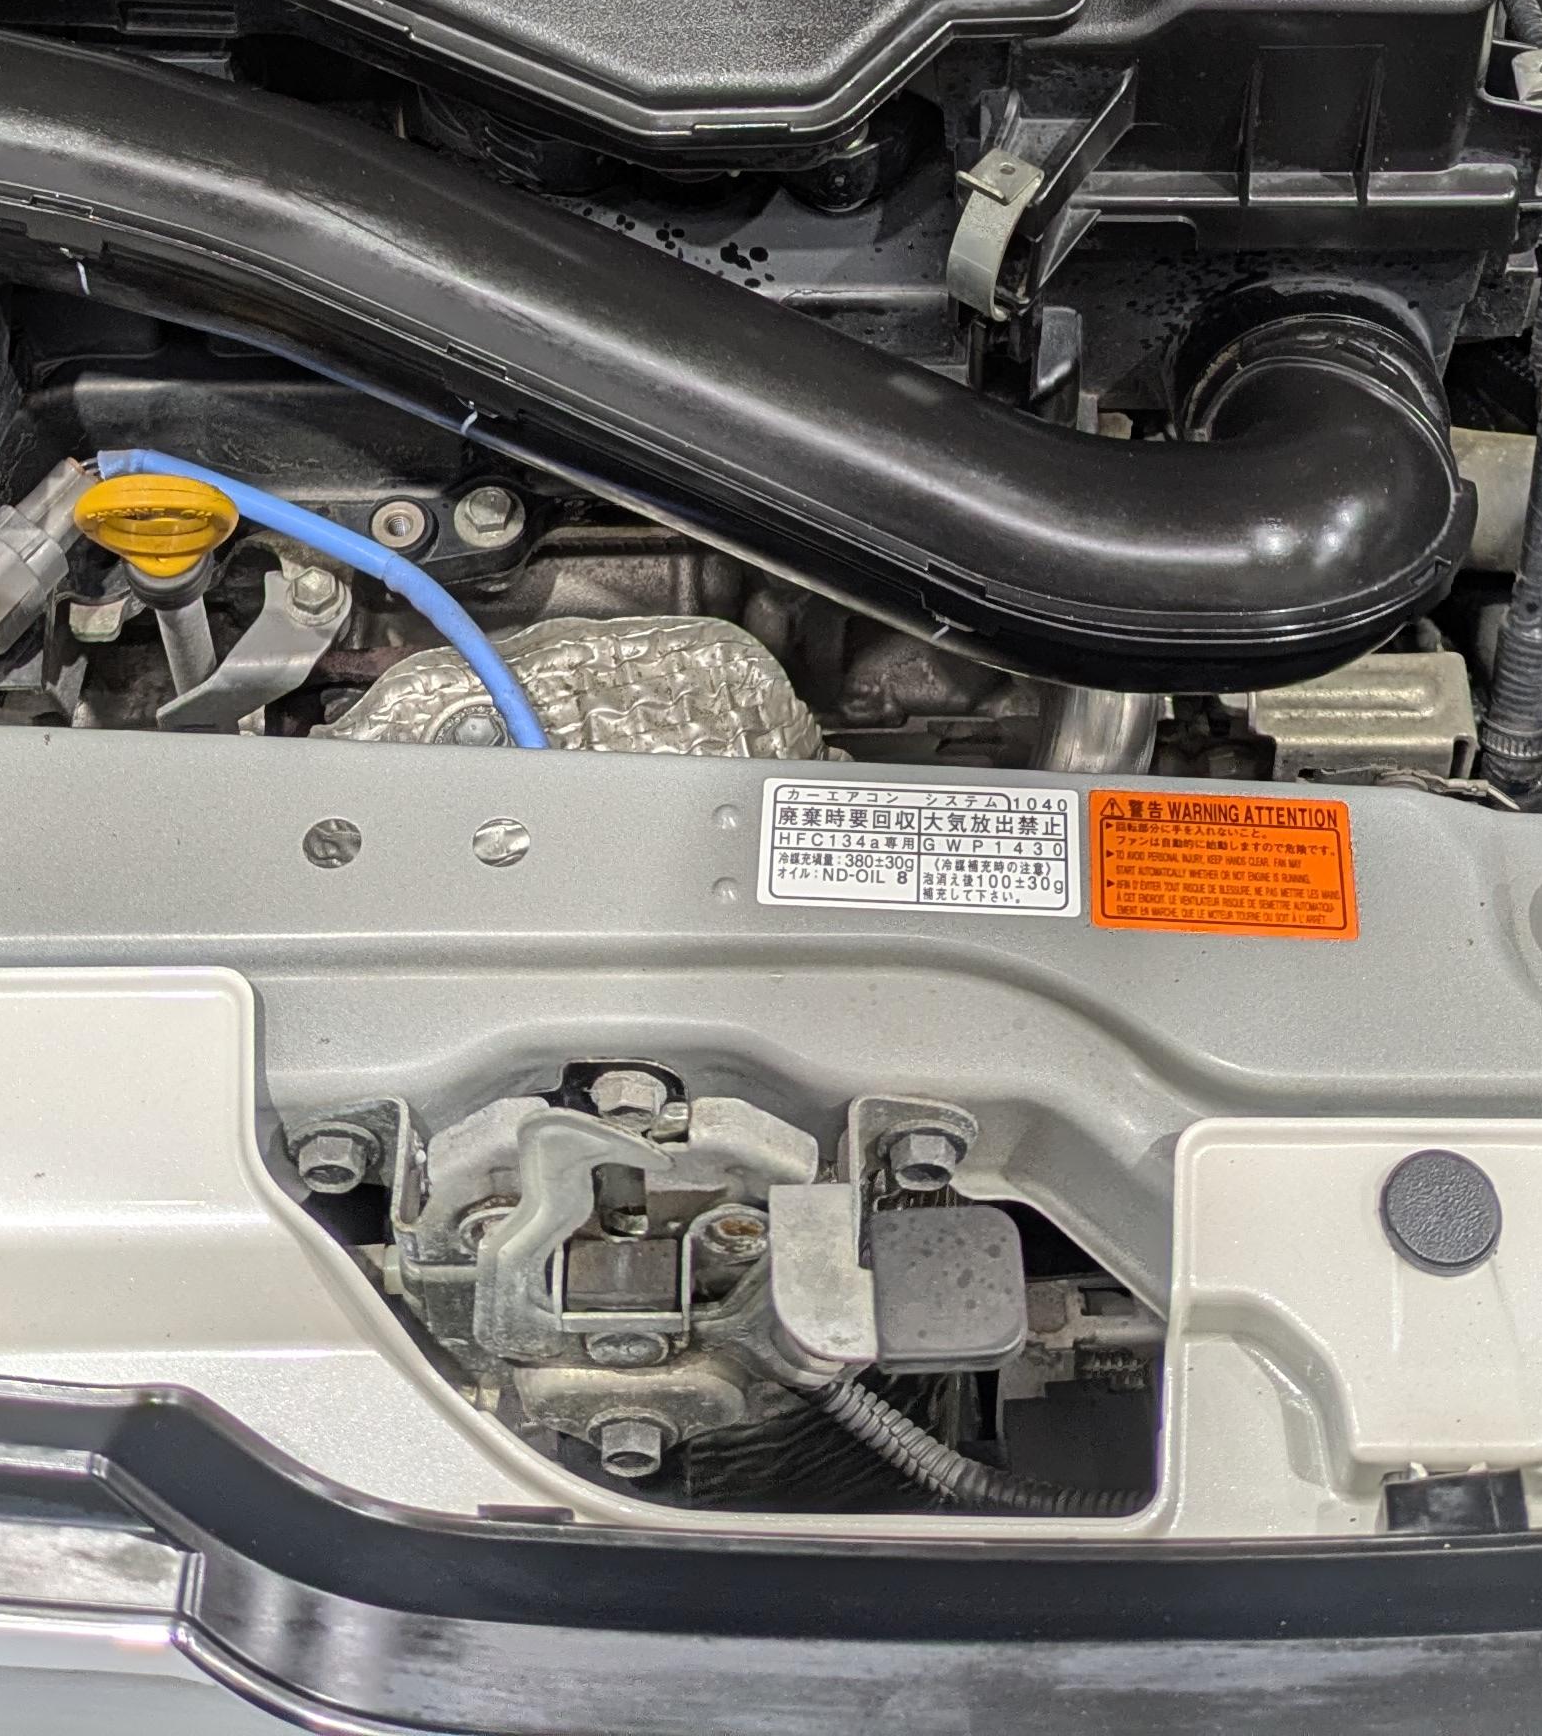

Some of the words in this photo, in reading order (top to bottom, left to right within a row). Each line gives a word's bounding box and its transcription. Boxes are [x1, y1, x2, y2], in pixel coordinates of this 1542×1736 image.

[786, 788, 899, 804] カーエアコン
[925, 793, 997, 807] システム
[1013, 796, 1067, 811] 1040
[778, 806, 915, 831] 廃棄時要回収
[923, 811, 1062, 836] 大気放出禁止
[1128, 799, 1163, 819] 警告
[1167, 801, 1240, 823] WARNING
[1244, 805, 1338, 828] ATTENTION
[778, 831, 914, 850] HFC134a専用
[1115, 821, 1267, 839] 回転部分に手を入れないこと。
[897, 871, 907, 884] 8
[922, 887, 1021, 903] 補充して下さい。
